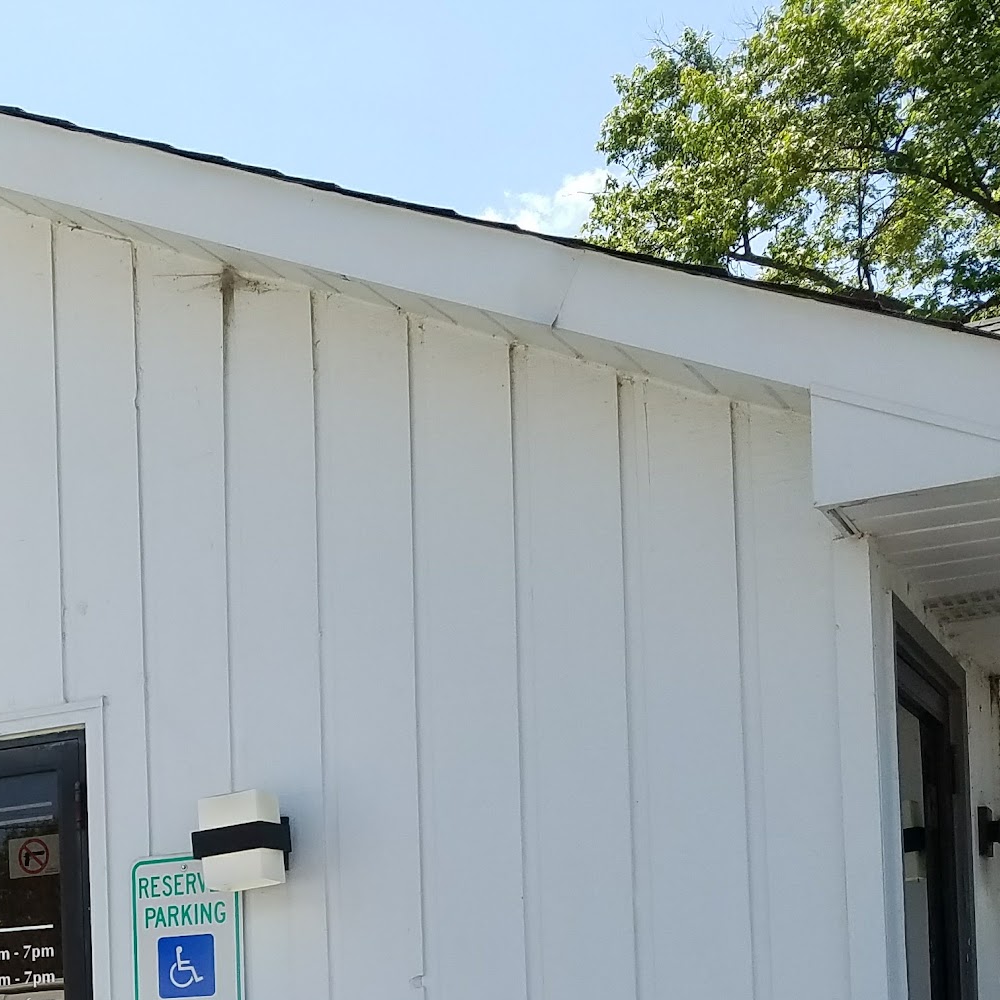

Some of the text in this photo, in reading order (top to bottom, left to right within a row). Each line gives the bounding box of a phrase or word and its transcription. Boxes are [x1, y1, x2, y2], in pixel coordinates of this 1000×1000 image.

[138, 872, 221, 899] RESERV
[145, 901, 227, 929] PARKING
[23, 944, 55, 960] 7pm
[24, 970, 56, 986] 7pm
